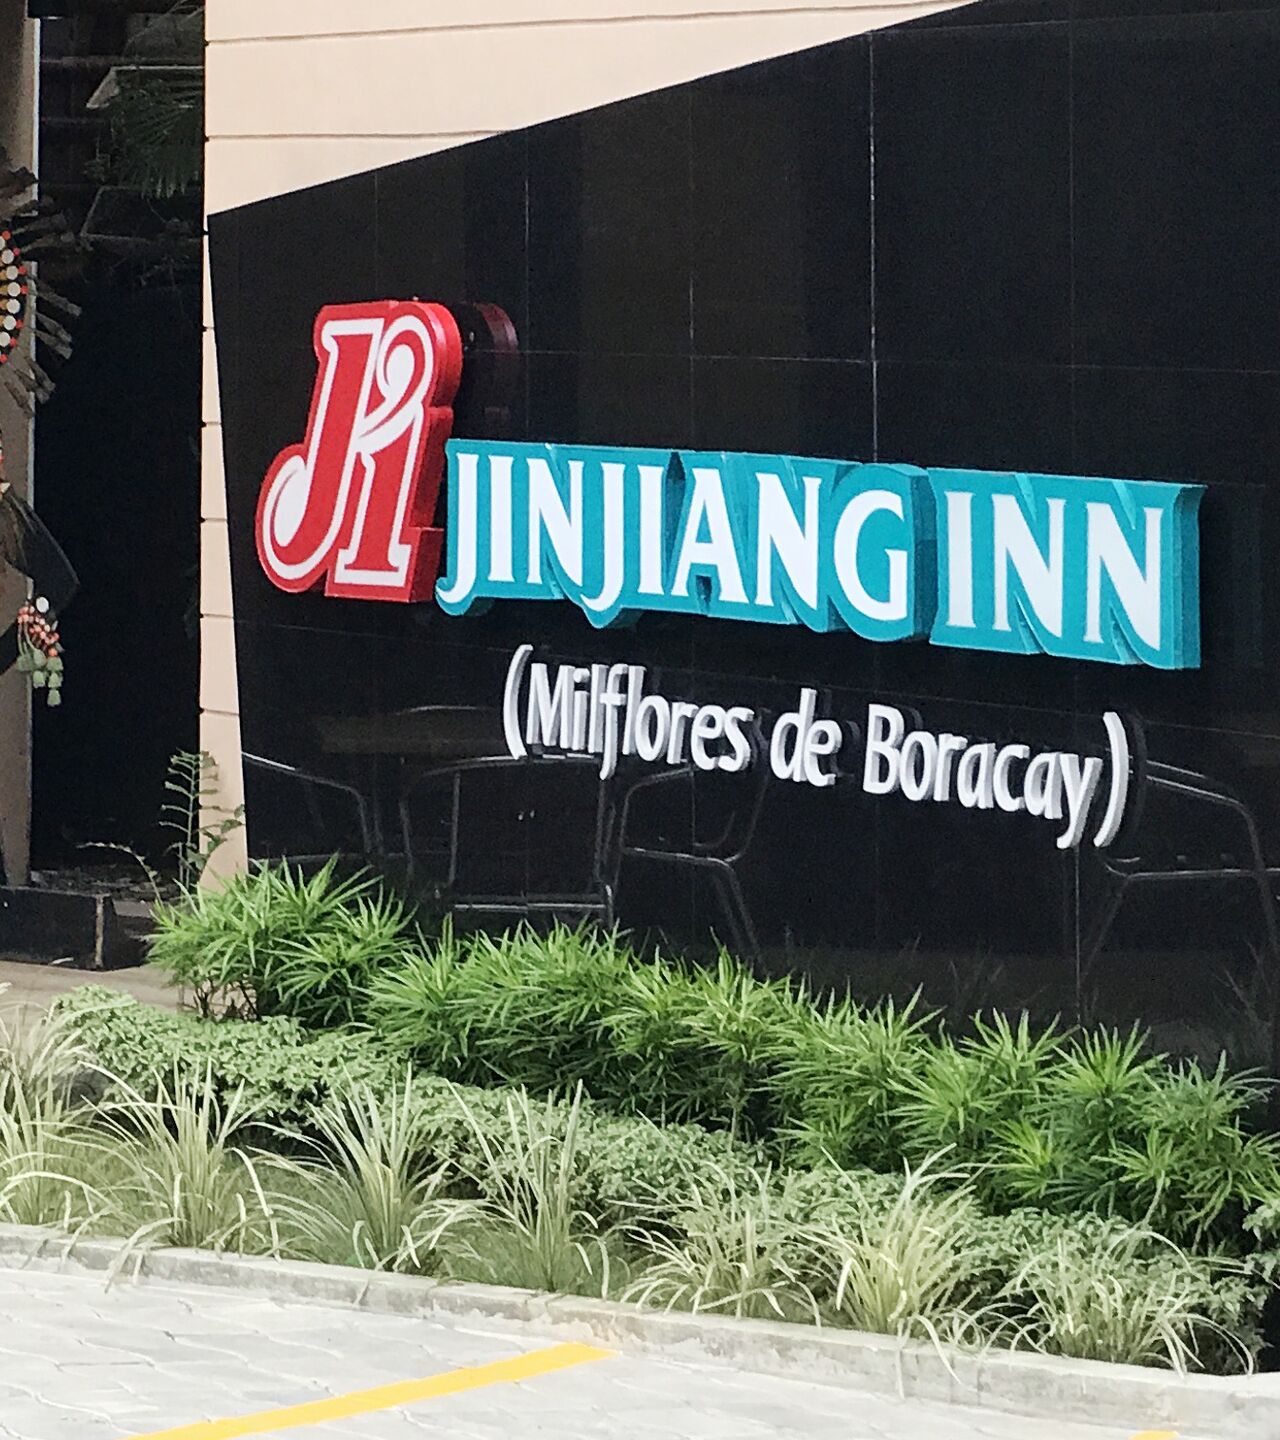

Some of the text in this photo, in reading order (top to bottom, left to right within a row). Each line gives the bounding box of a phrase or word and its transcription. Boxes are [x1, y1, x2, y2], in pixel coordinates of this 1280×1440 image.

[435, 450, 1164, 654] JINJIANG INN
[503, 644, 1130, 851] (Milflores de Boracay)
